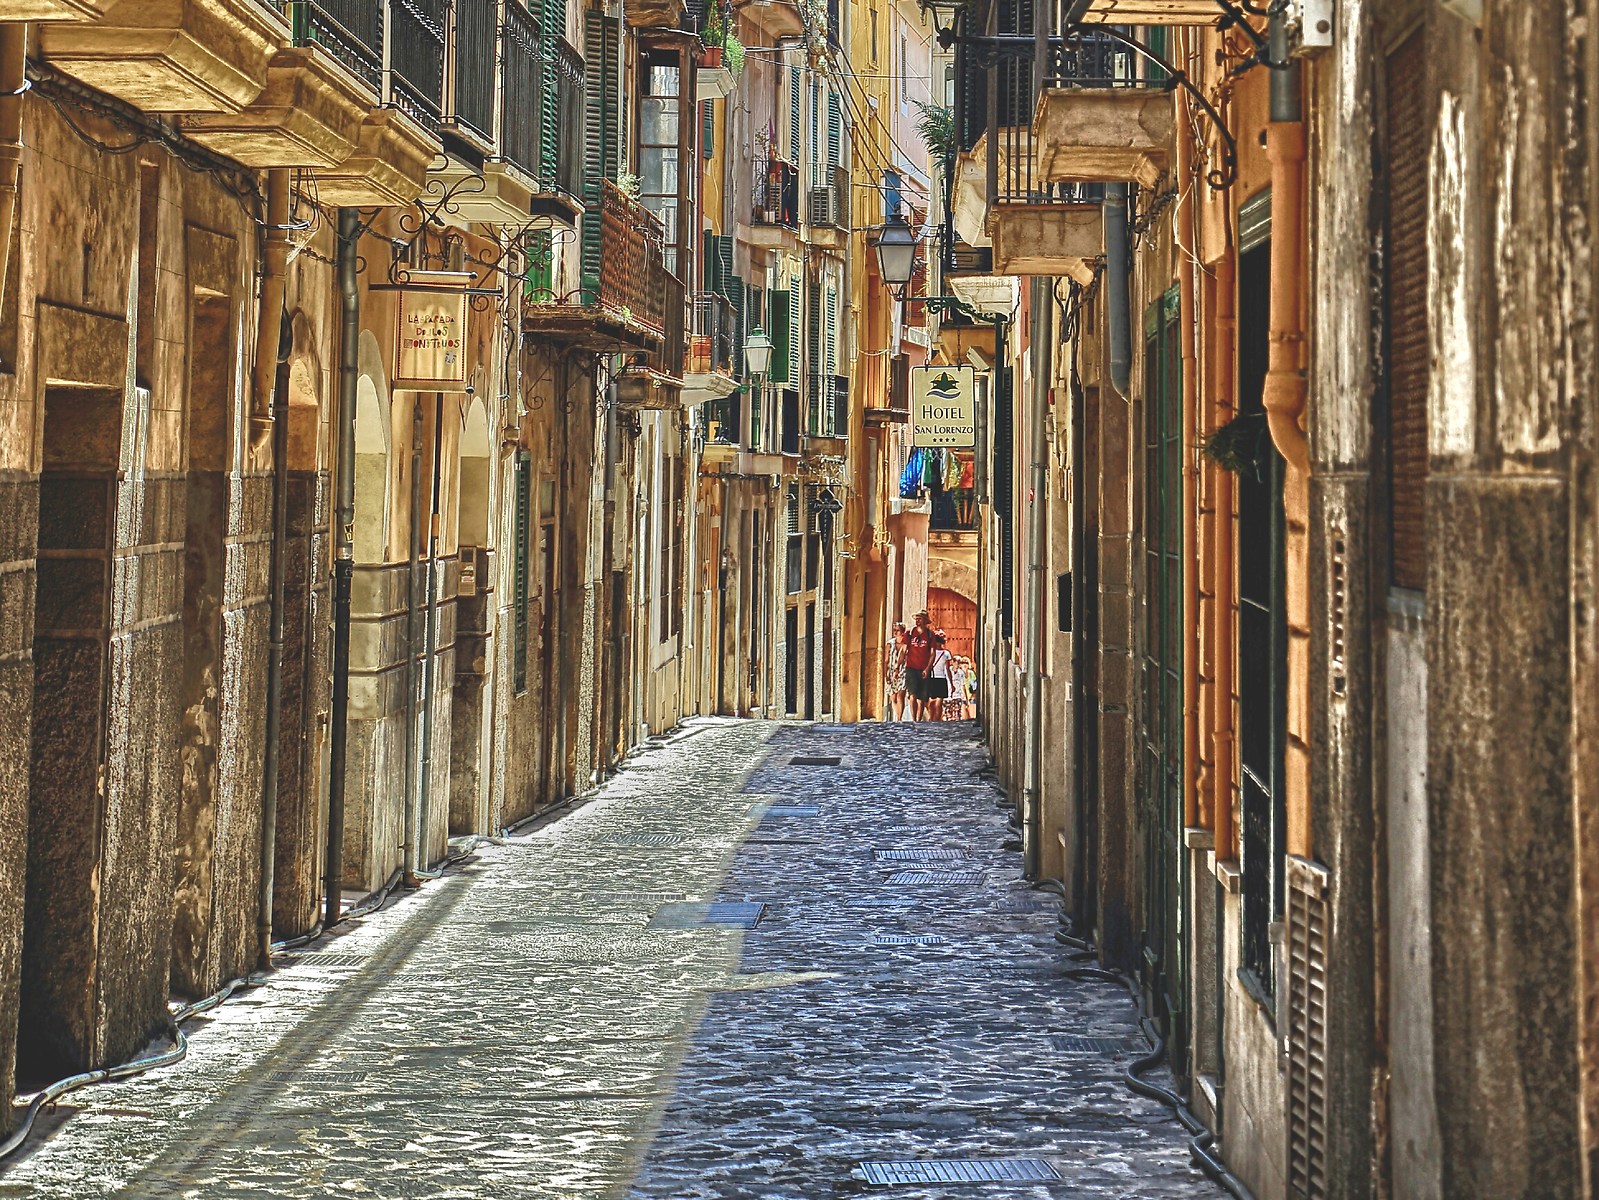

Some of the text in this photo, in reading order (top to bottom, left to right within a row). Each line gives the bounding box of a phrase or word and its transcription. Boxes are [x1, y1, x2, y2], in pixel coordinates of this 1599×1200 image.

[408, 314, 419, 324] LA
[432, 326, 449, 337] LOS
[922, 404, 965, 420] HOTEL
[914, 424, 974, 435] SAN LORENZO
